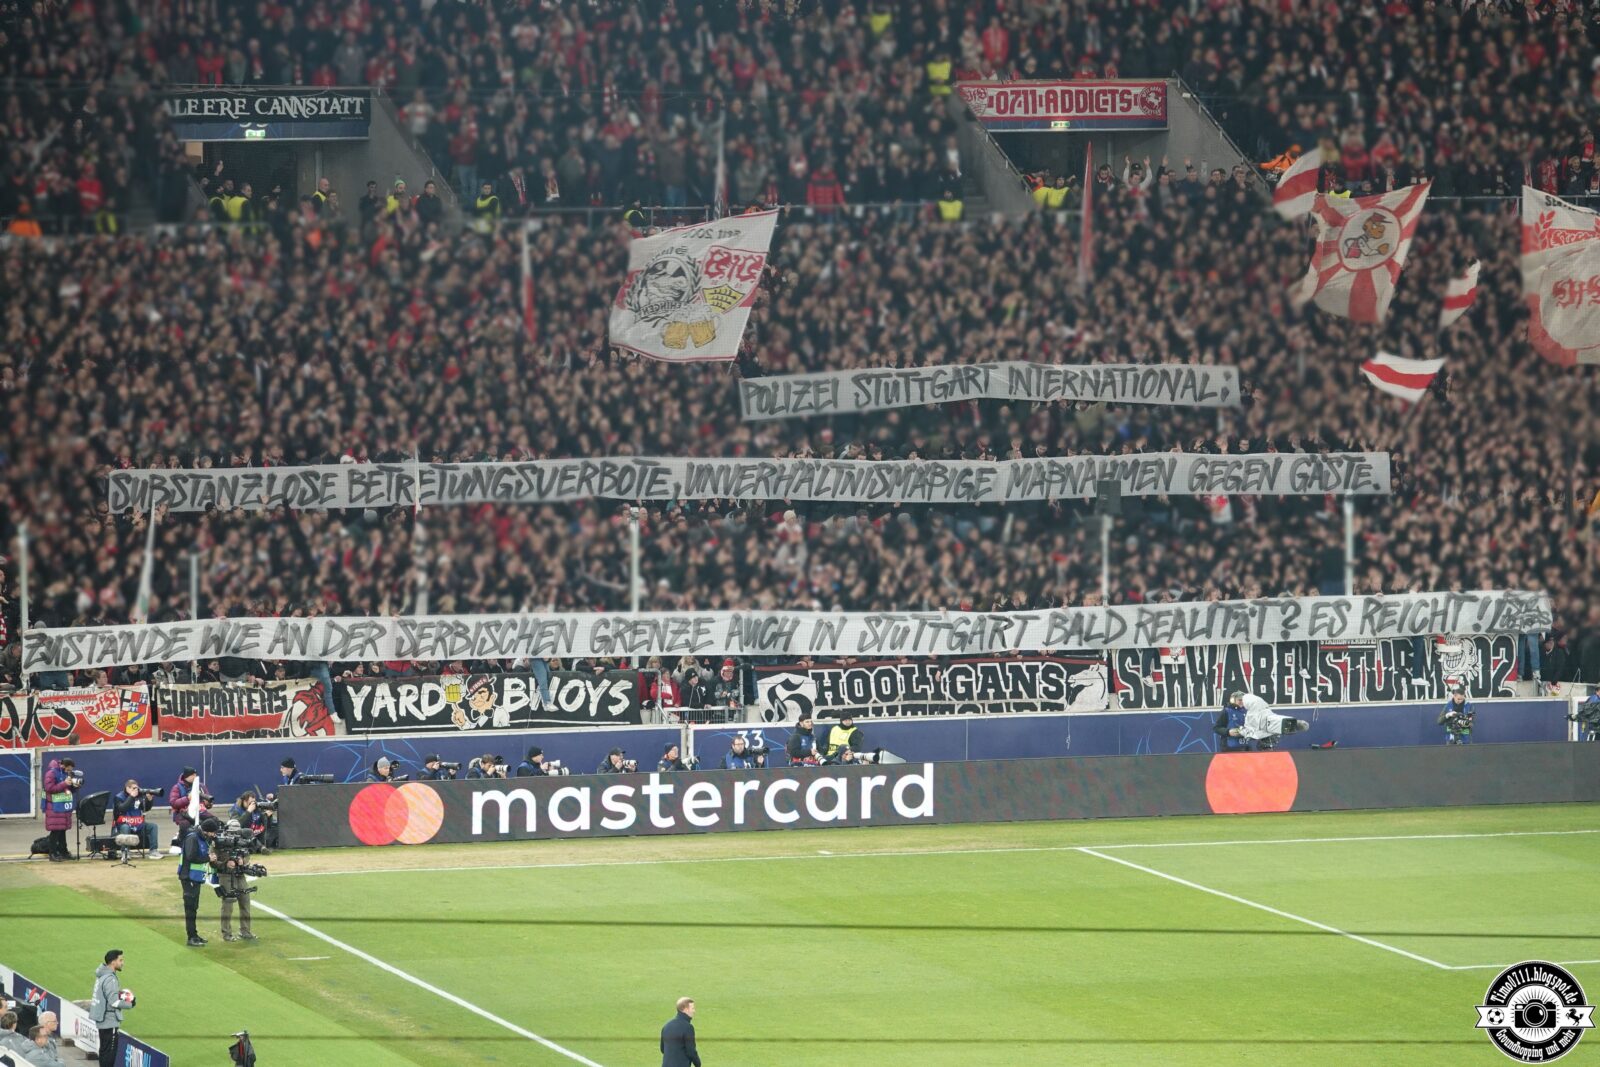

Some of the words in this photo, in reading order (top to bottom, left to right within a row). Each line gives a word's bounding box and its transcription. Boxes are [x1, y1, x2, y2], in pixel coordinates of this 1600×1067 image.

[254, 96, 365, 119] CANNSTATT
[740, 377, 840, 415] POLIZEI
[852, 364, 999, 409] STUTTGART
[1008, 363, 1233, 402] INTERNATIONAL:
[110, 469, 339, 511] SUBSTANZLOSE
[1188, 456, 1283, 493] GEGEN
[1290, 454, 1381, 494] GÄSTE.
[200, 620, 263, 656] WIE
[267, 618, 314, 656] AN
[318, 619, 387, 658] DER
[395, 617, 578, 658] SERBISCHEN
[589, 616, 716, 655] GRENZE
[725, 612, 801, 653] AUCH
[808, 615, 848, 652] IN
[857, 611, 1040, 653] STUTTGART
[1042, 608, 1127, 647] BALD
[1307, 598, 1353, 639] ES
[159, 684, 288, 719] SUPPORTERS
[346, 681, 447, 722] YARD
[809, 661, 1068, 707] HOOLIGANS
[471, 762, 934, 835] mastercard
